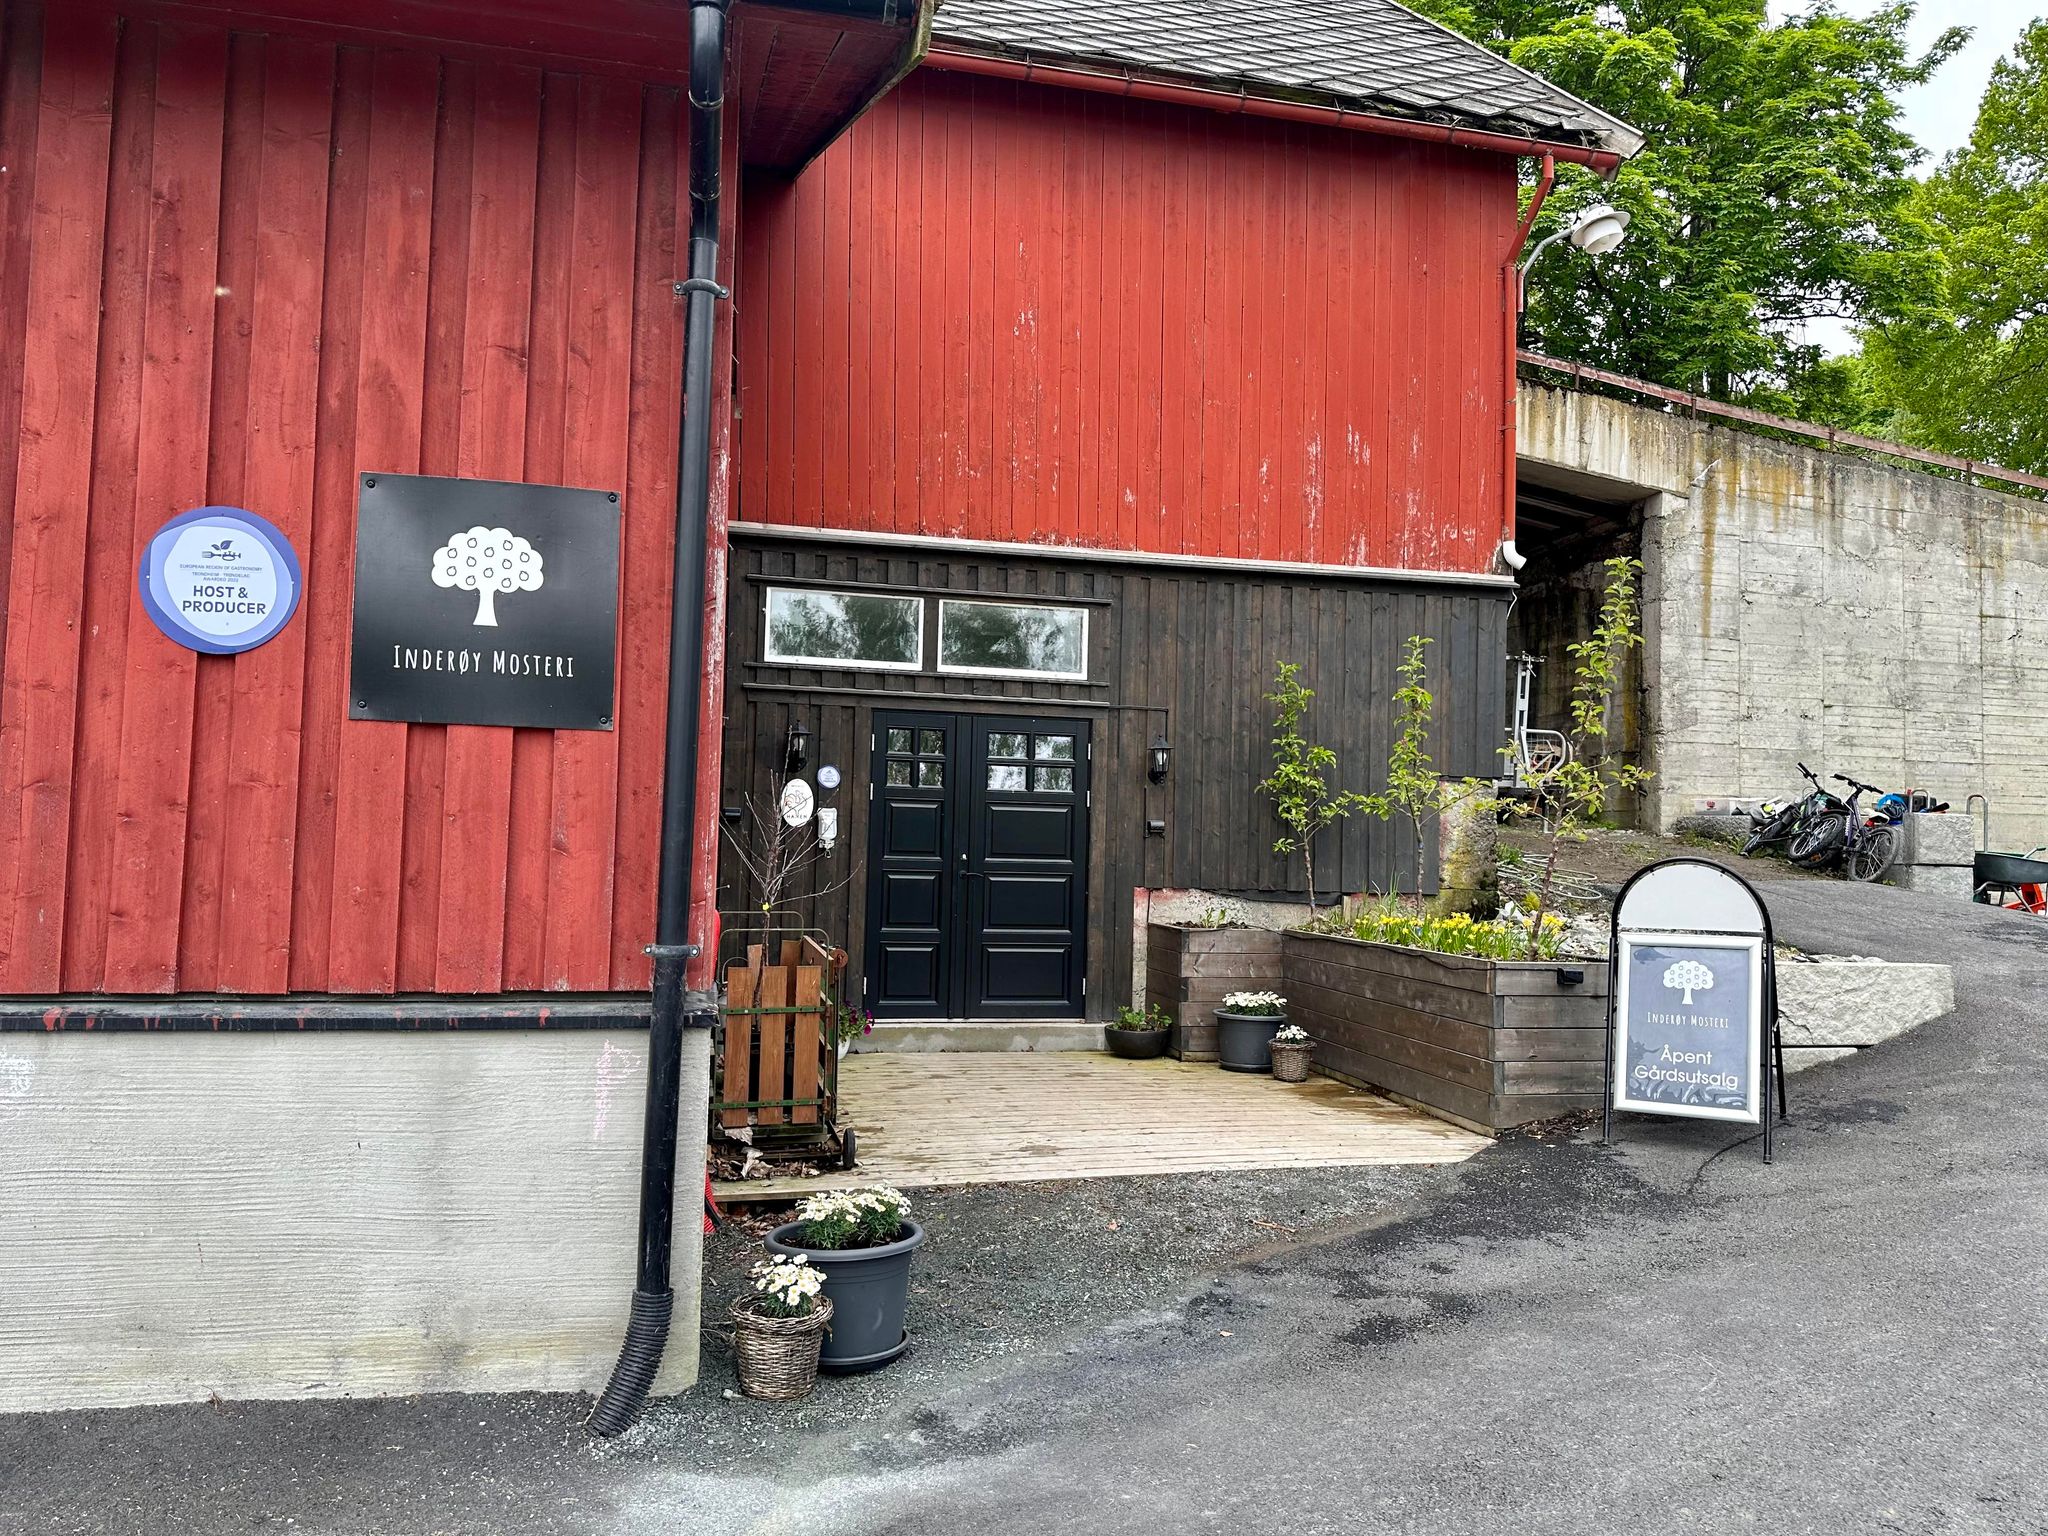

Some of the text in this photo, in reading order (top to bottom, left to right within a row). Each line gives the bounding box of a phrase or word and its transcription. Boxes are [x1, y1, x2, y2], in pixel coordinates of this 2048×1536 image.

[193, 585, 248, 598] HOST &
[182, 600, 266, 614] PRODUCER
[1660, 1044, 1712, 1065] Åpent
[1634, 1065, 1739, 1090] Gårdsutsalg
